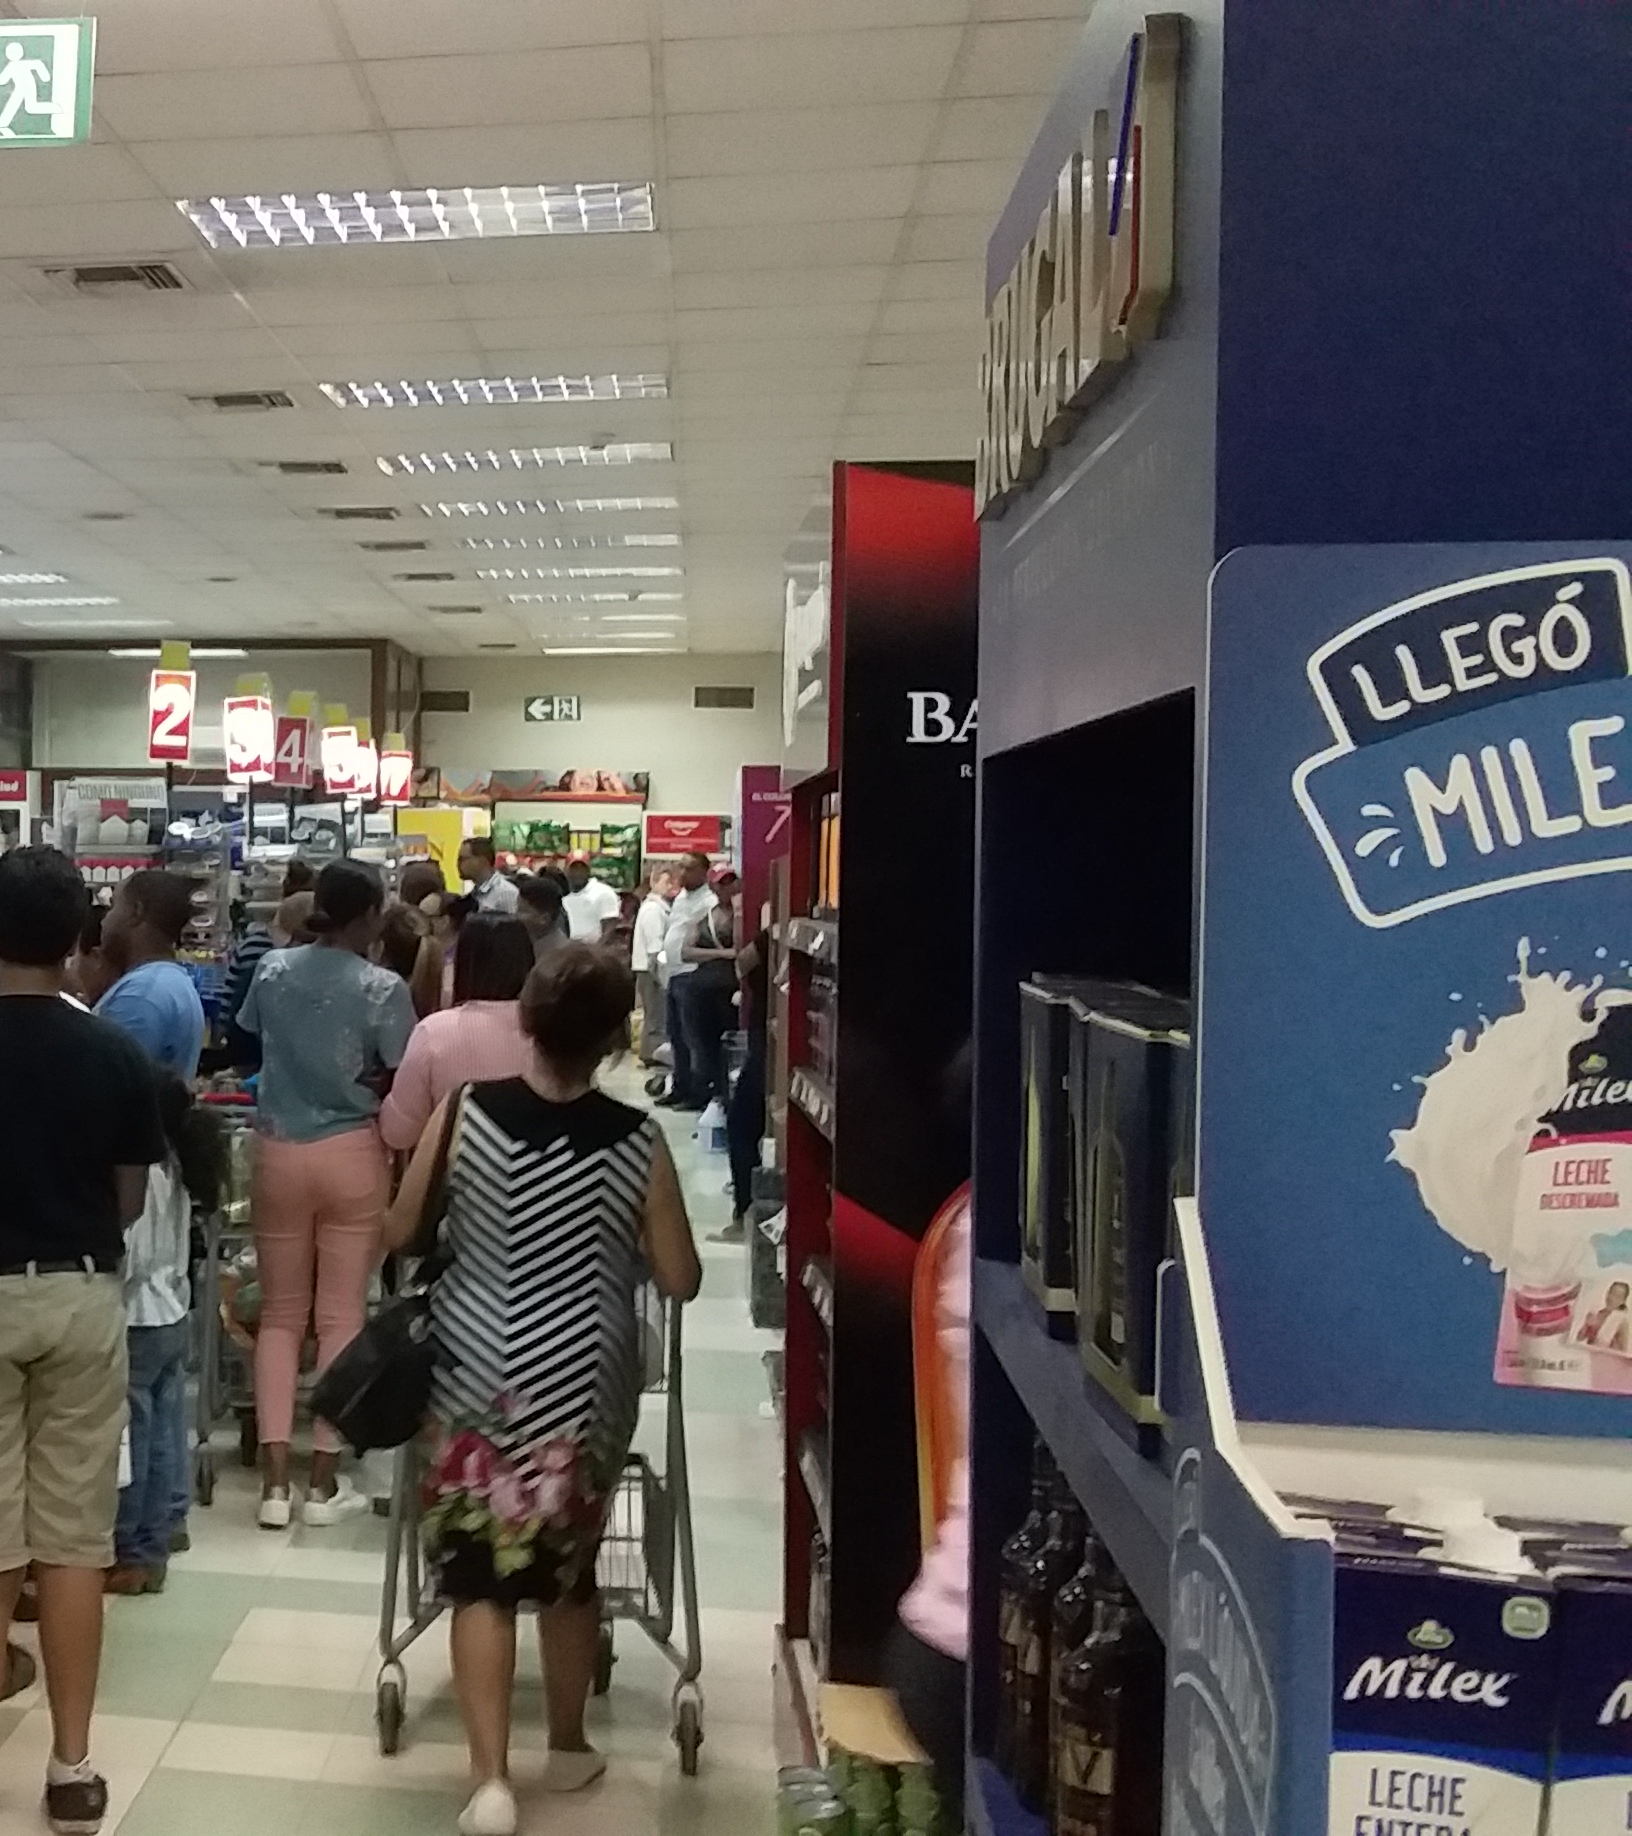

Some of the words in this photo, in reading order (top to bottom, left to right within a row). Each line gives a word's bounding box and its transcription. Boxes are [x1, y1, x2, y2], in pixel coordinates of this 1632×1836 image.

[1350, 581, 1592, 721] LLEGÓ
[151, 683, 190, 746] 2
[276, 729, 304, 773] 4
[1553, 1158, 1613, 1187] LECHE
[1342, 1655, 1519, 1708] Milex
[1368, 1767, 1466, 1817] LECHE
